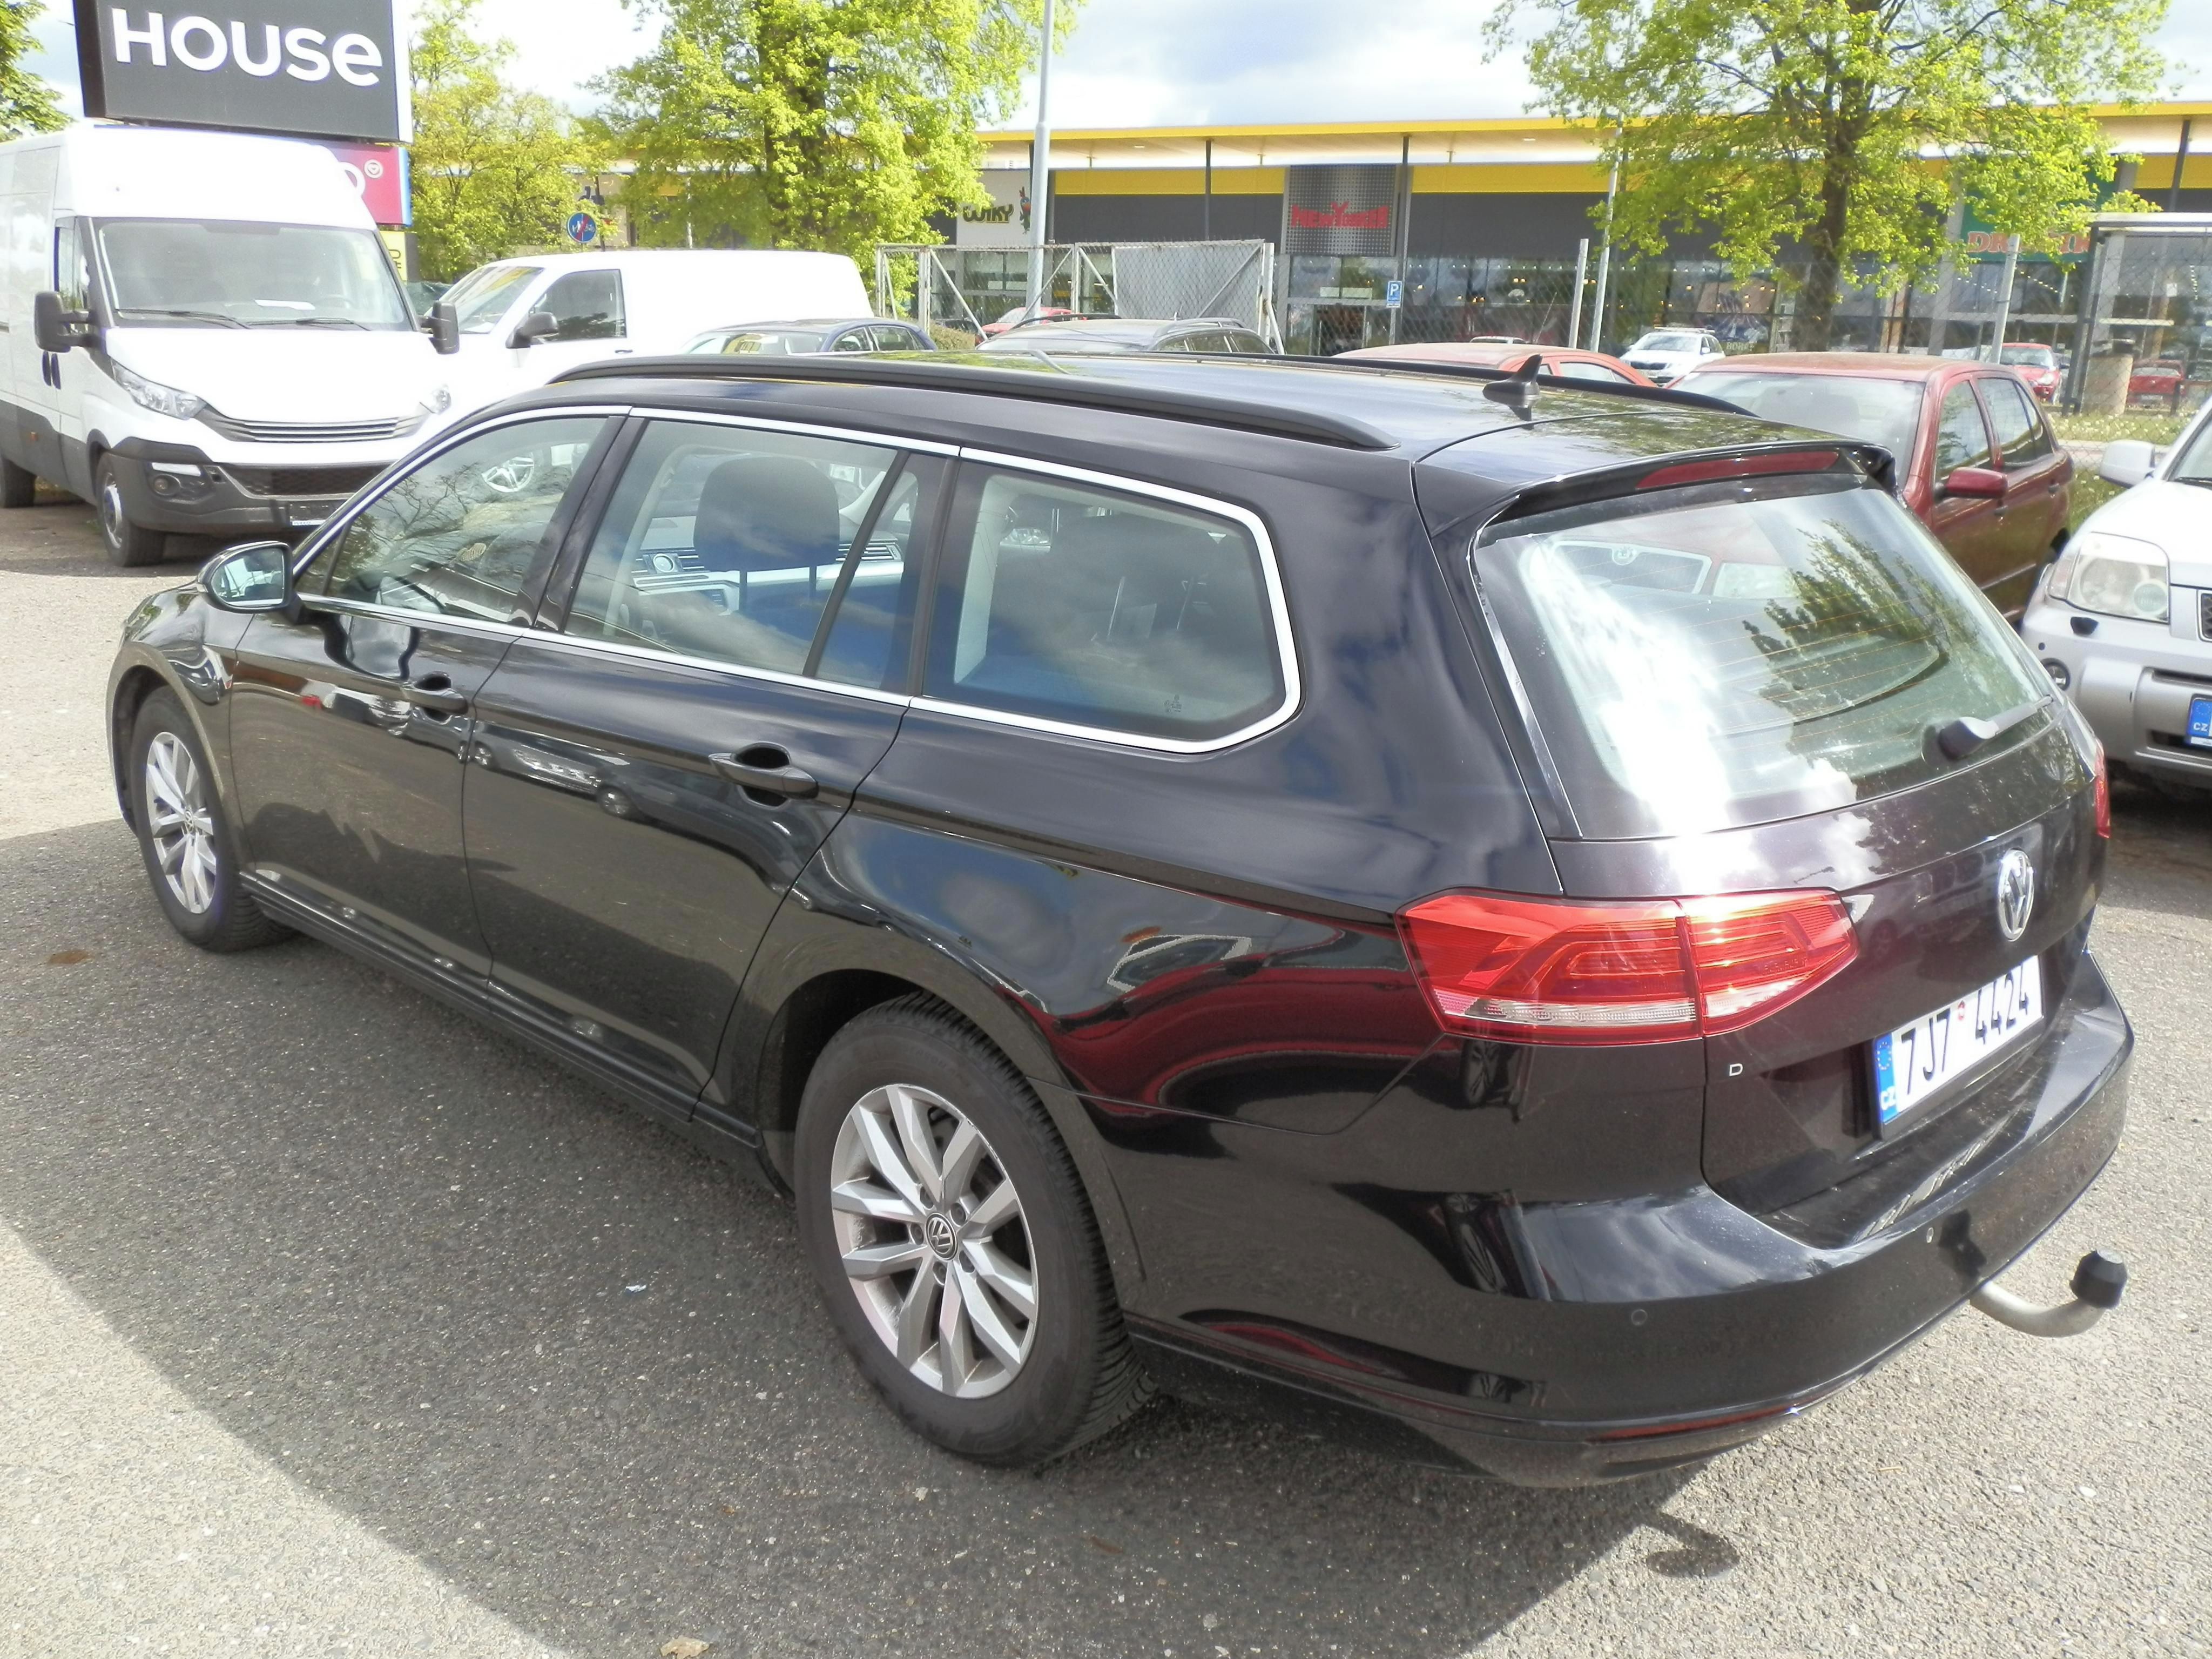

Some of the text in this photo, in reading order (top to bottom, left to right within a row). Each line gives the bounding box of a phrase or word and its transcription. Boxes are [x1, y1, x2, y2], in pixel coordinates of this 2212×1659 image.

[1390, 284, 1399, 296] P
[2194, 722, 2208, 732] CZ
[1900, 963, 2029, 1095] 7J7 4424
[1729, 1063, 1743, 1076] D
[1880, 1085, 1897, 1110] CZ
